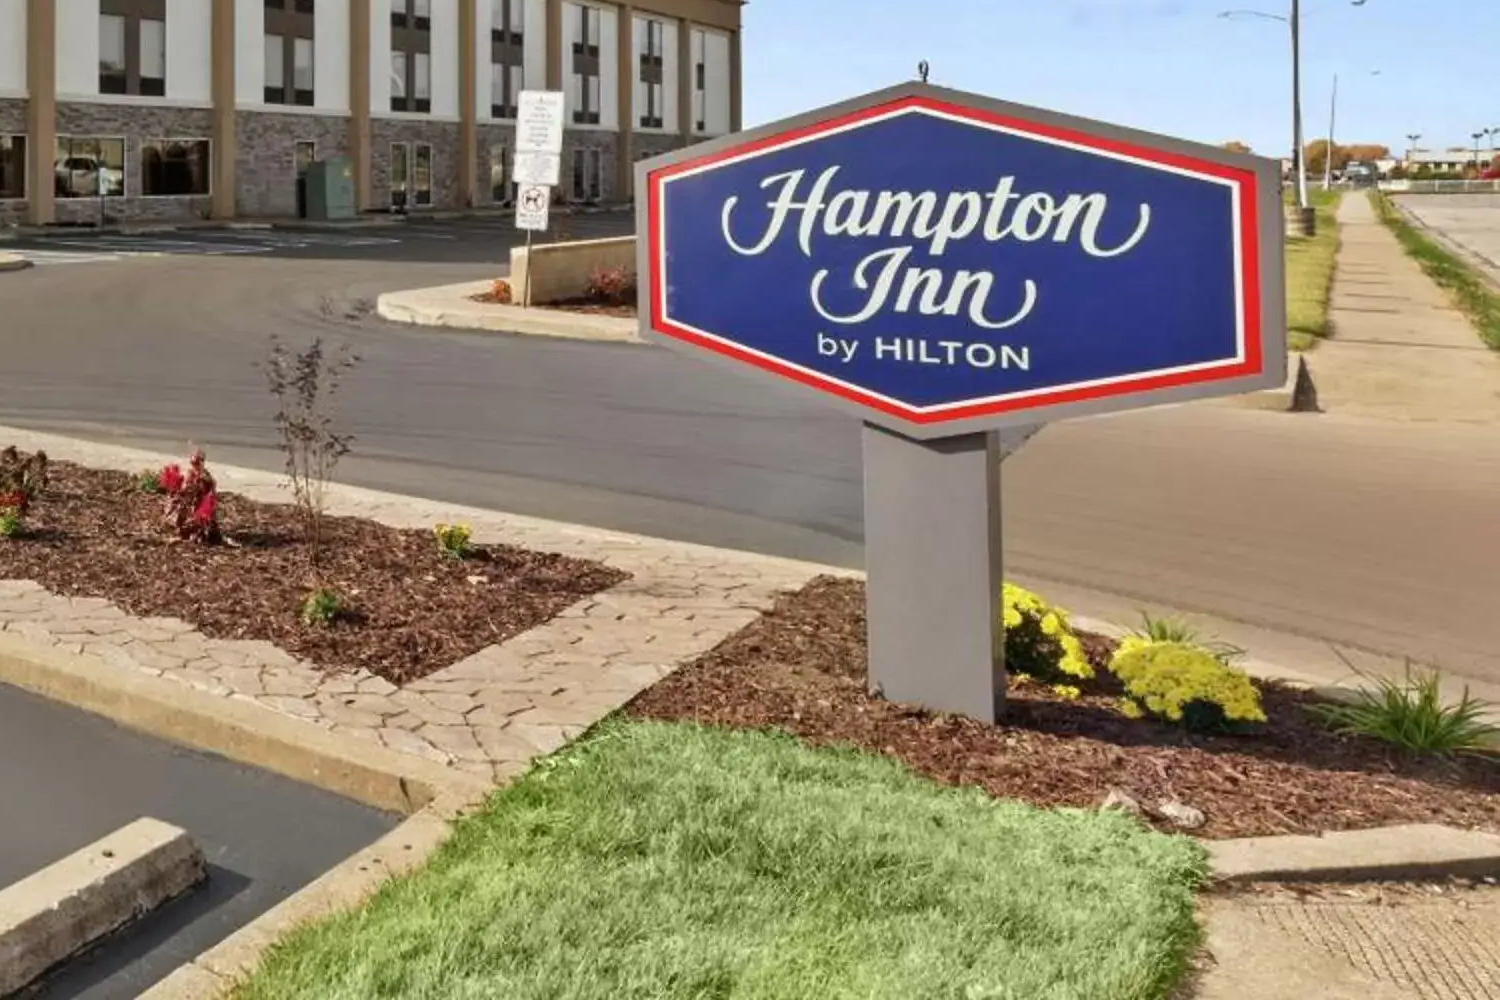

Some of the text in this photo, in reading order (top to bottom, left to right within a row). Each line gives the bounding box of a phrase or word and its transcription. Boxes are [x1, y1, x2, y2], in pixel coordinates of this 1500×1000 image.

[721, 165, 1151, 257] Hampton
[809, 245, 1037, 329] Inn
[817, 332, 1030, 370] by HILTON
